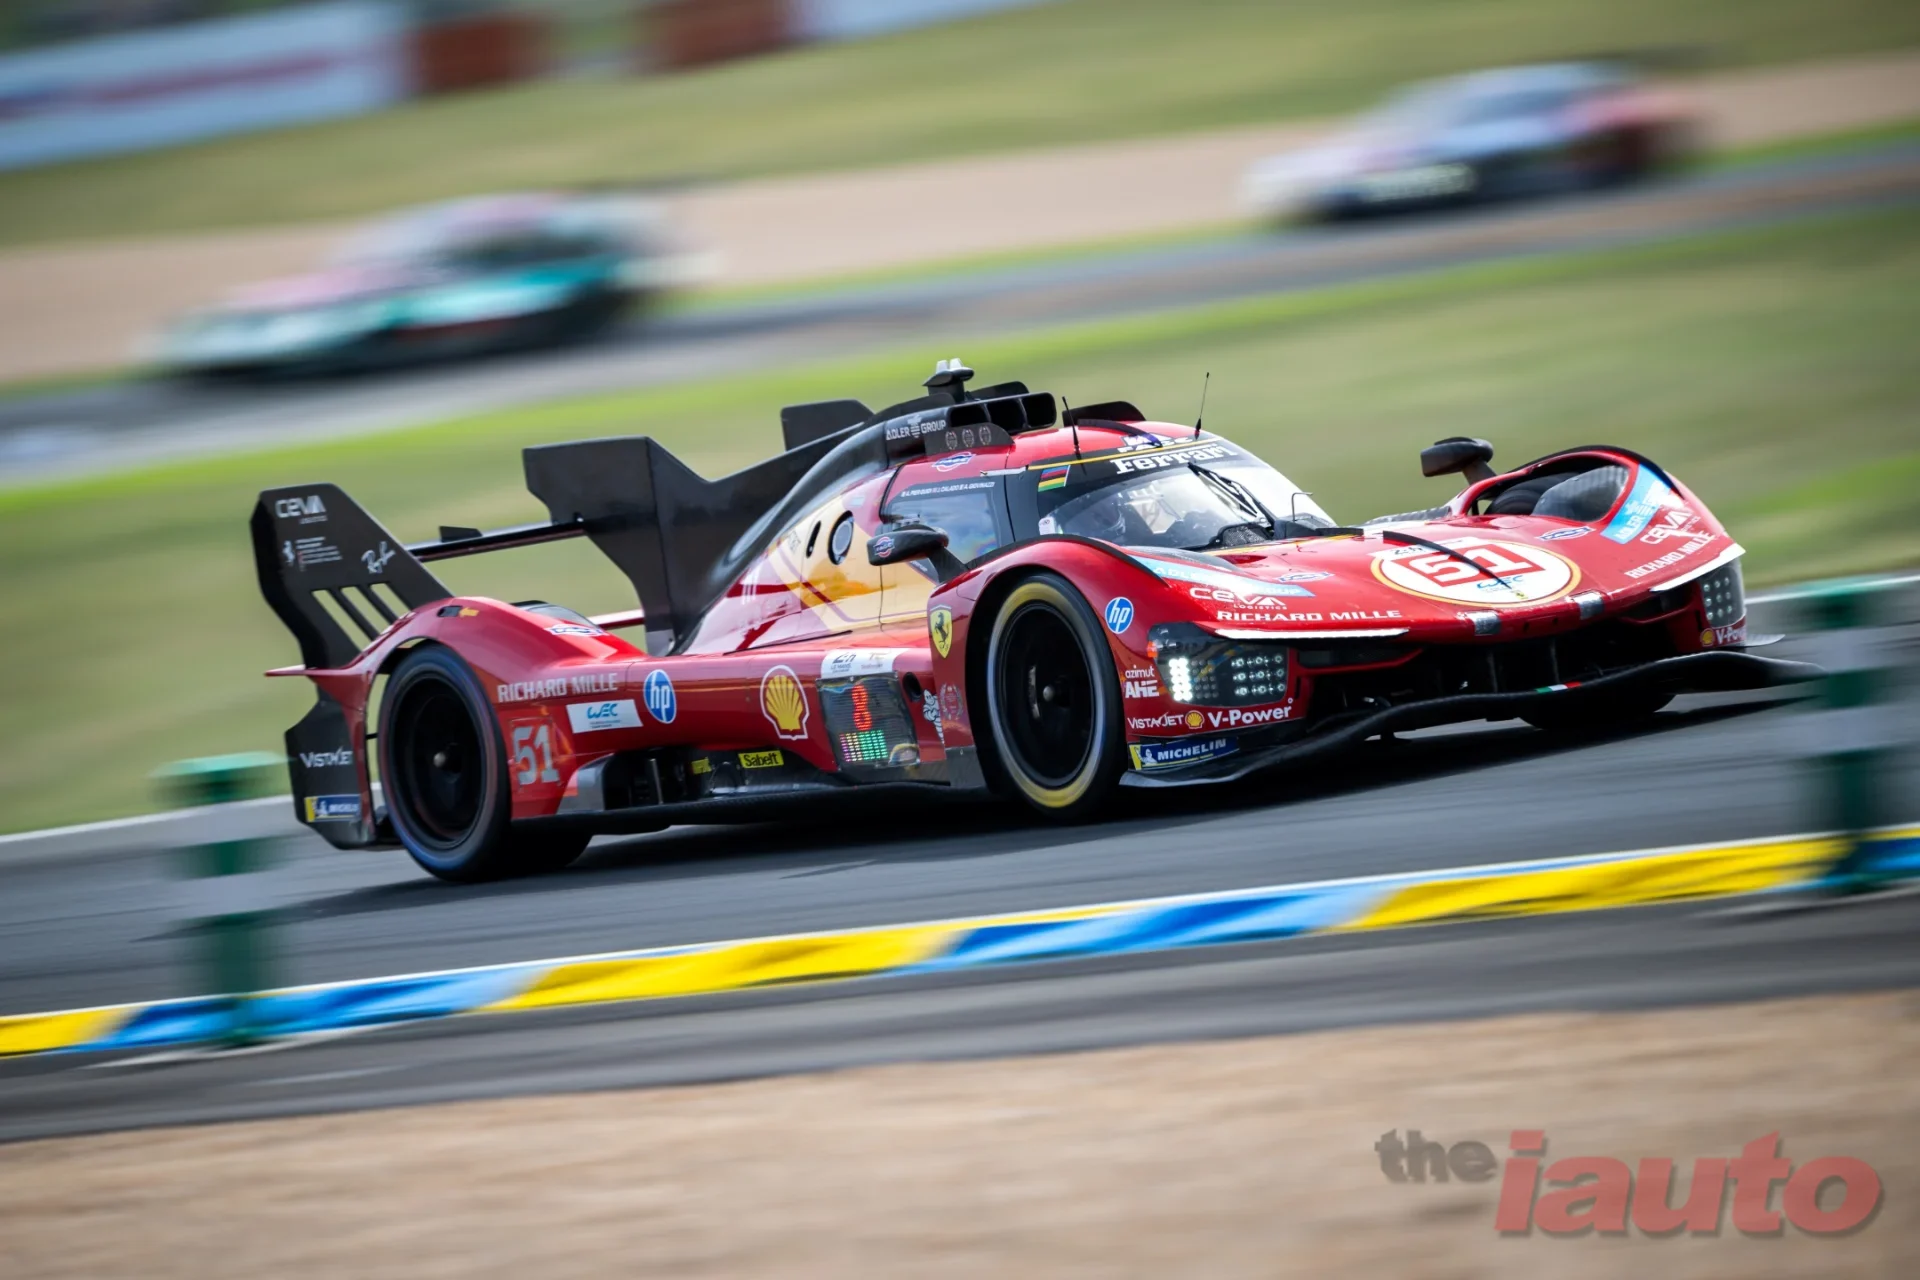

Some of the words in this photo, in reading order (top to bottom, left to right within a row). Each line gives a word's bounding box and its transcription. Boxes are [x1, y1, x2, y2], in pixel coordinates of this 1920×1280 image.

[886, 426, 911, 441] ADLER
[920, 419, 947, 434] GROUP
[1110, 443, 1238, 474] Ferrari
[1408, 548, 1534, 584] 51
[1624, 551, 1686, 579] RICHARD
[1677, 530, 1716, 555] MILLE
[1107, 599, 1131, 633] hp
[1216, 610, 1324, 622] RICHARD
[1329, 609, 1402, 620] MILLE
[1233, 603, 1288, 611] LOGISTICS
[1125, 665, 1155, 679] azimut
[497, 678, 567, 703] RICHARD
[571, 672, 618, 695] MILLE
[647, 672, 673, 722] hp
[587, 702, 618, 719] WEC
[1208, 706, 1292, 728] V-Power
[512, 724, 560, 785] 51
[743, 752, 779, 767] Sabelt
[1157, 738, 1226, 761] MICHELIN
